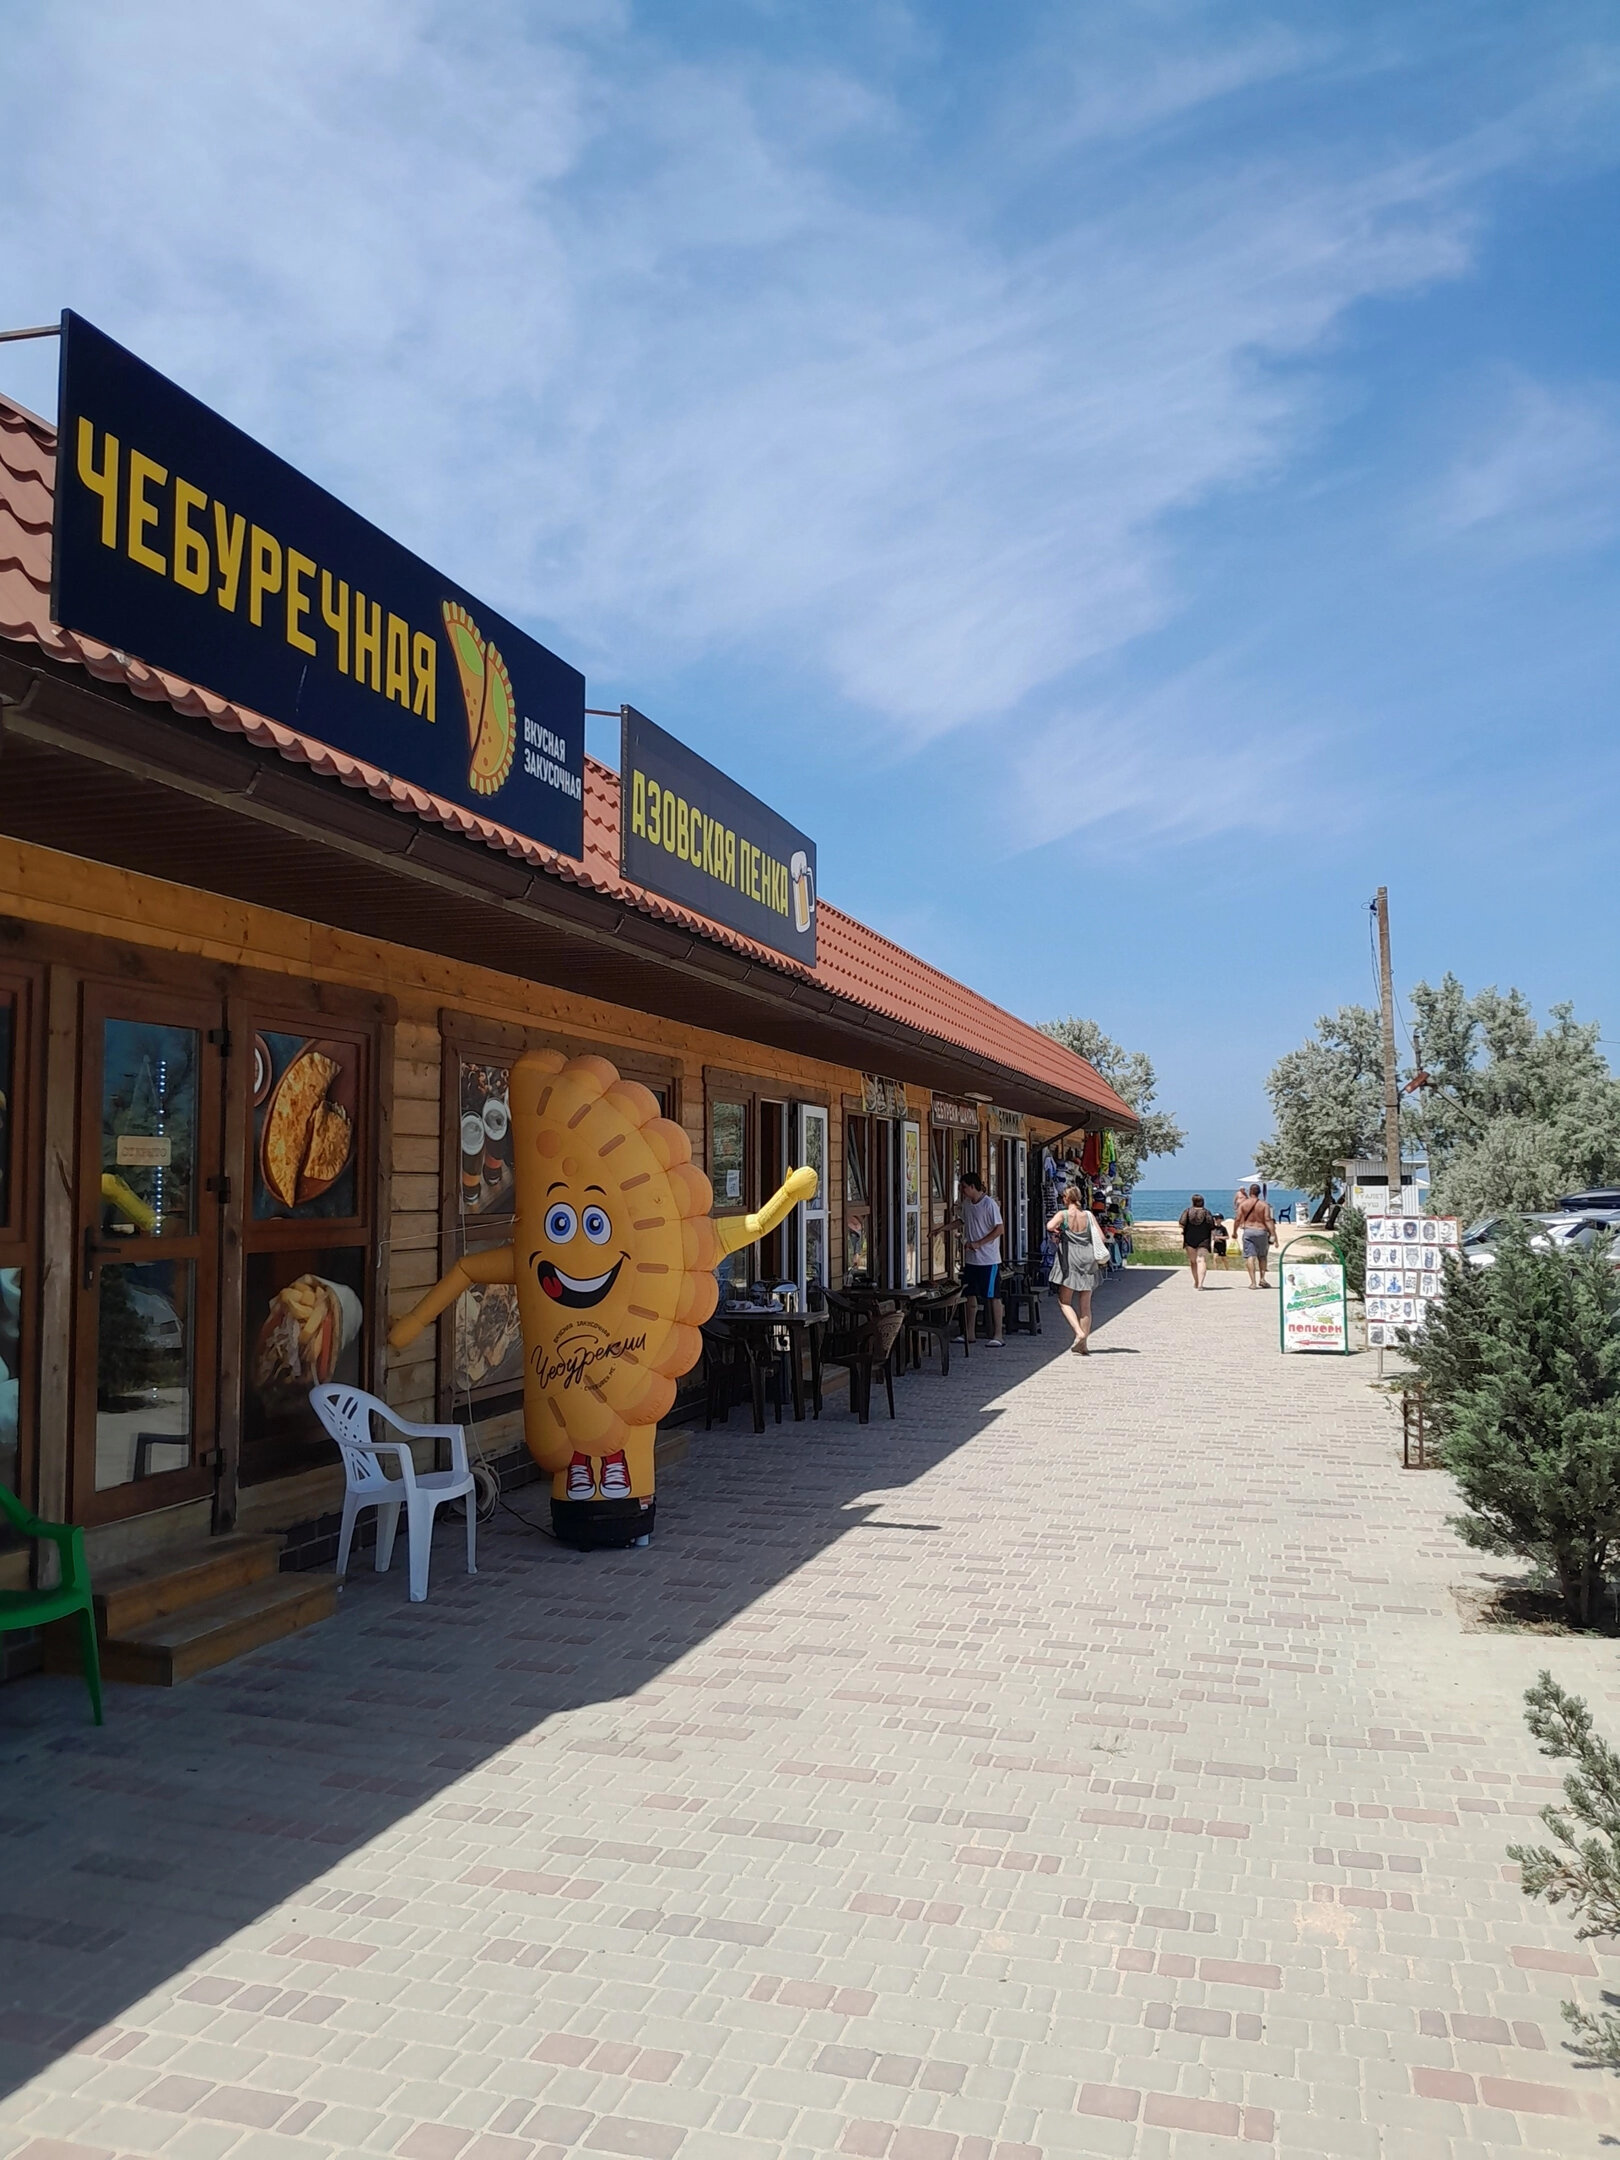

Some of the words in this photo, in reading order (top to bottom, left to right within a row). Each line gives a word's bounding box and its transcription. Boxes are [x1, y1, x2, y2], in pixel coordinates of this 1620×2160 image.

[77, 416, 436, 723] ЧЕБУРЕЧНАЯ
[524, 716, 565, 763] ВКУСНАЯ
[524, 748, 581, 801] ЗАКУСОЧНАЯ
[632, 769, 735, 887] АЗОВСКАЯ
[740, 838, 788, 917] ПЕНКА
[1288, 1324, 1342, 1333] ПОПКОРН
